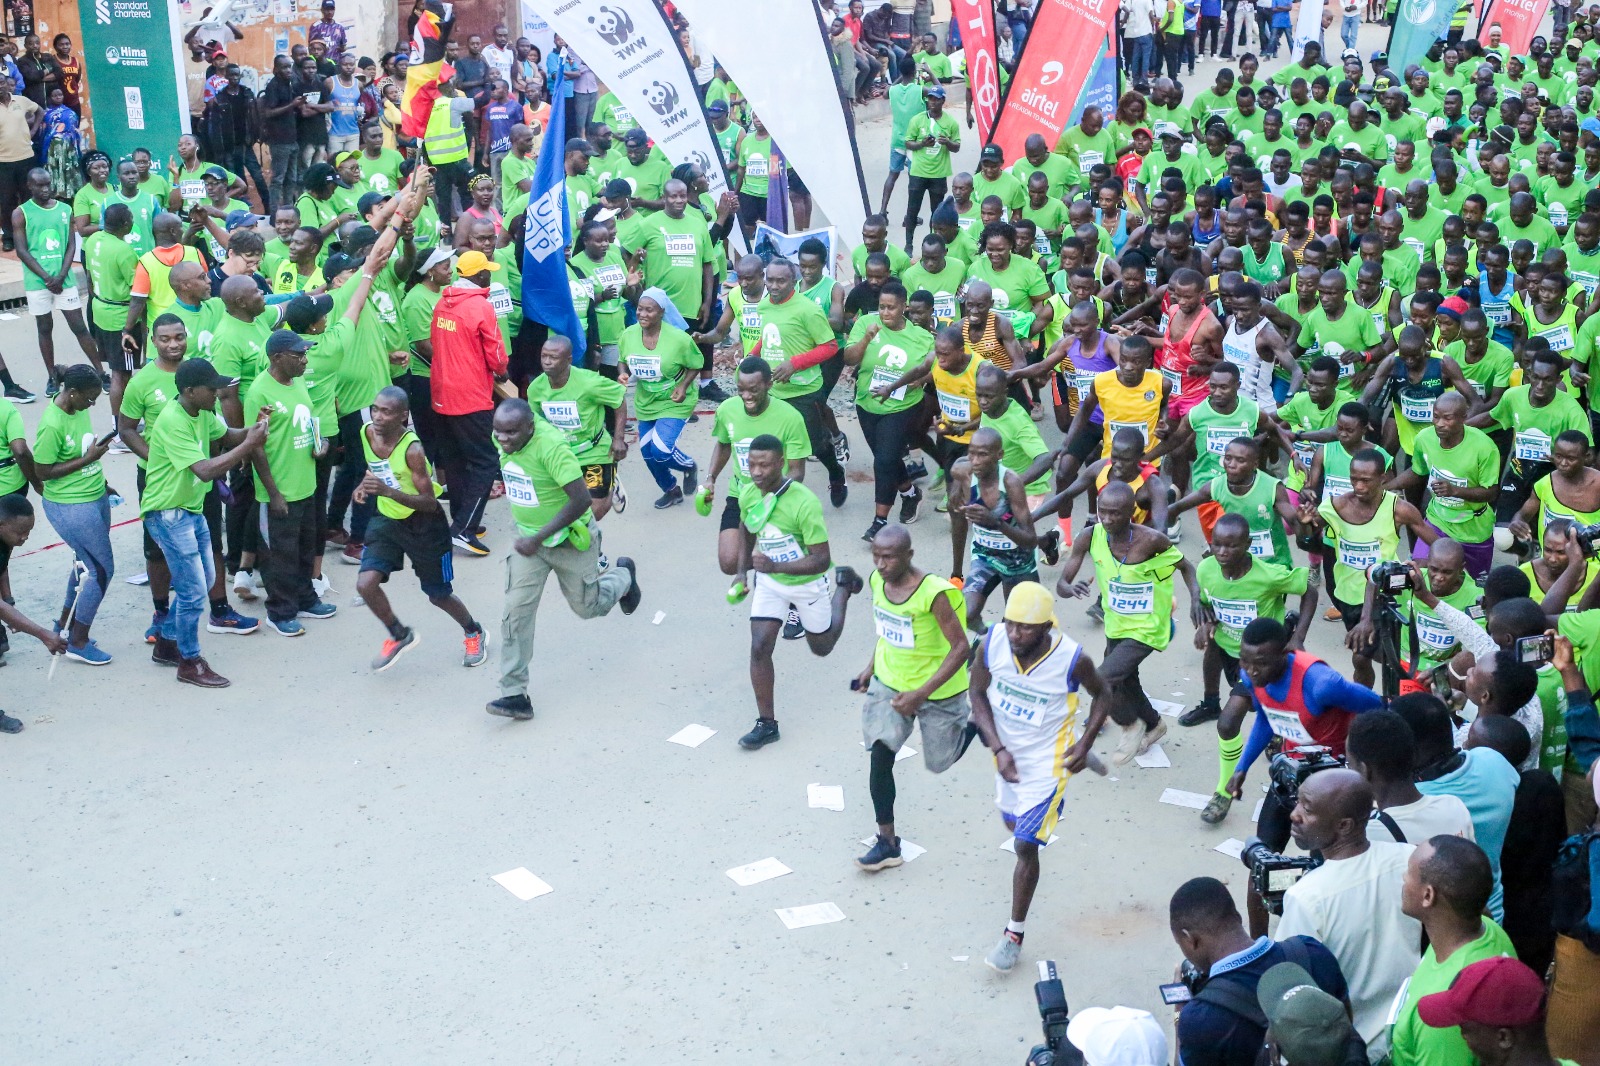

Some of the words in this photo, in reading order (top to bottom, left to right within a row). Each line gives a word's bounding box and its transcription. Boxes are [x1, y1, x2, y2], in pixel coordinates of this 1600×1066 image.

[113, 1, 149, 10] standard
[114, 9, 151, 19] chartered
[1083, 11, 1107, 28] IMAGINE
[1503, 8, 1527, 22] money
[120, 46, 147, 57] Hima
[121, 59, 149, 67] cement
[1021, 87, 1060, 119] airtel
[1012, 102, 1032, 118] REASON
[1032, 112, 1040, 122] TO
[1039, 116, 1061, 133] IMAGINE
[667, 243, 694, 251] 3080
[600, 273, 624, 283] 3083
[493, 299, 510, 310] 013
[1549, 338, 1567, 350] 214
[633, 368, 657, 378] 1149
[1405, 407, 1432, 418] 1891
[507, 487, 532, 501] 1330
[979, 537, 1012, 549] 1450
[1343, 554, 1377, 566] 1243
[1111, 597, 1148, 610] 1244
[1218, 611, 1253, 626] 1322
[882, 625, 904, 643] 1211
[1422, 630, 1455, 646] 1318
[999, 697, 1035, 721] 1134
